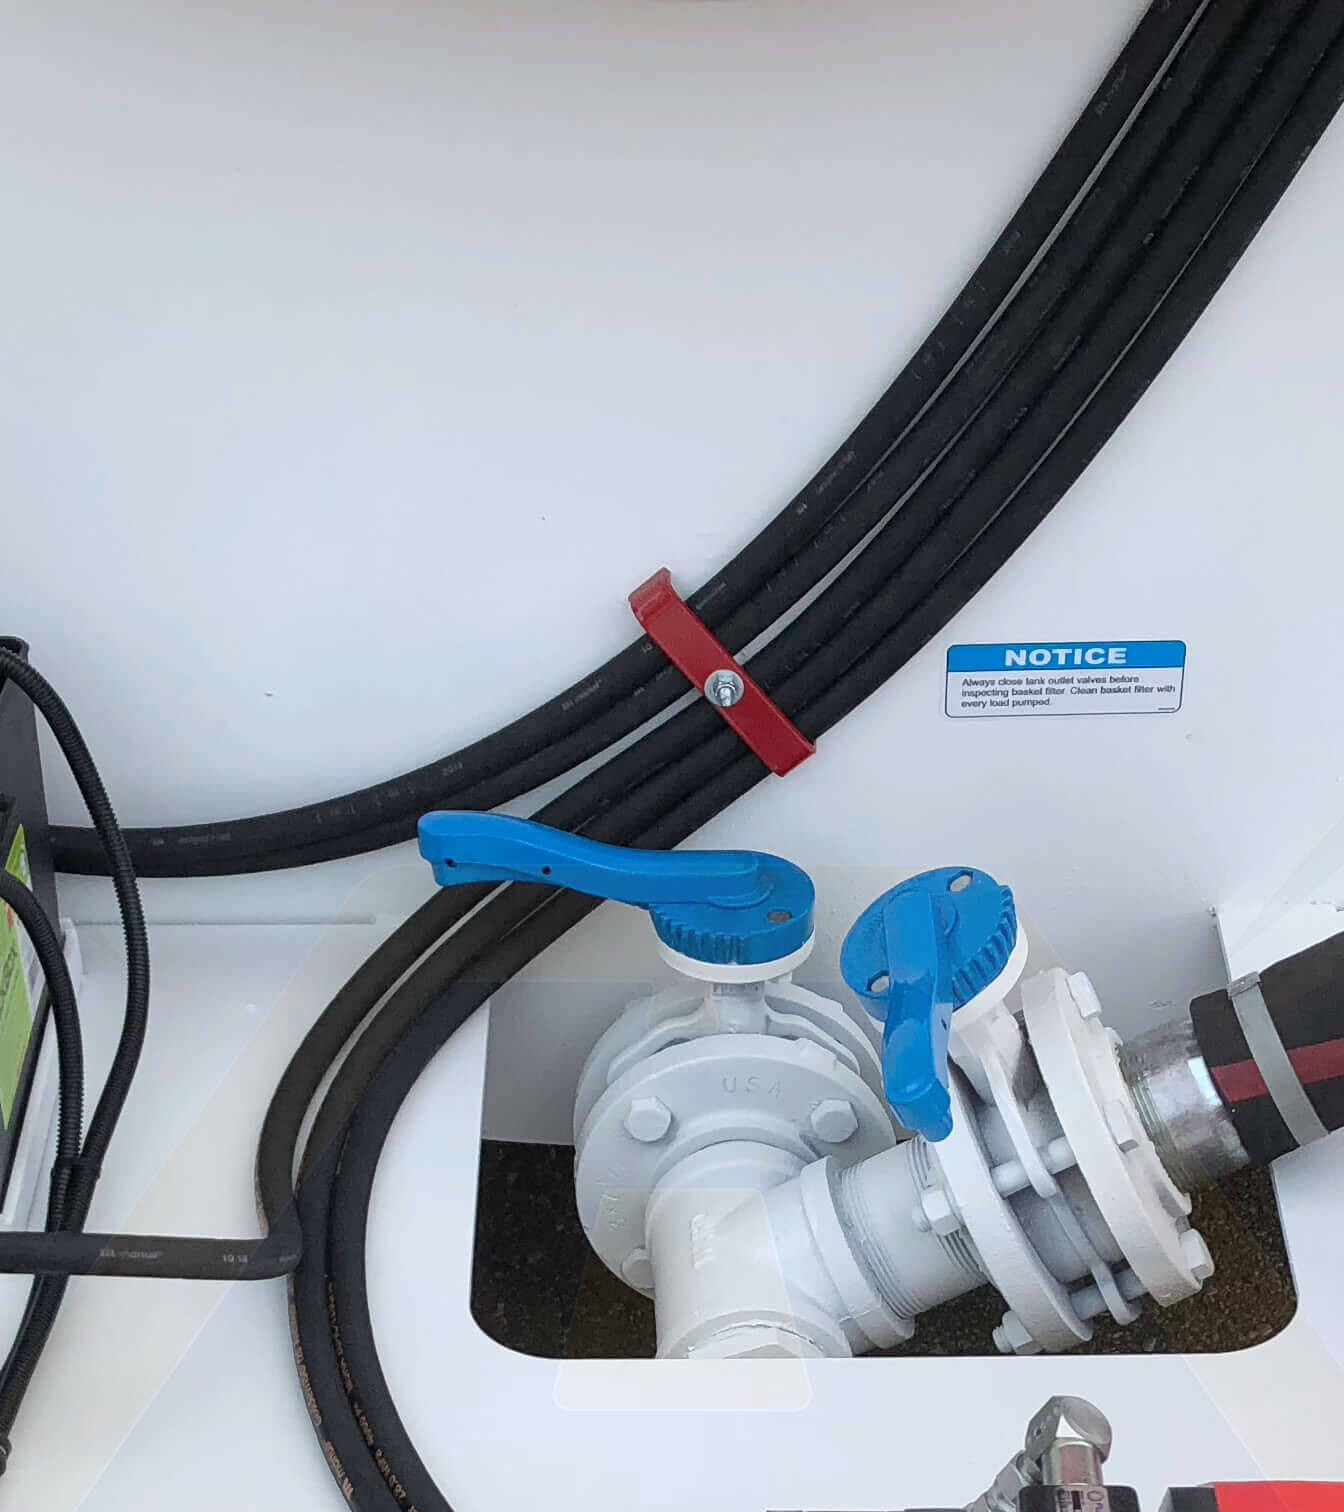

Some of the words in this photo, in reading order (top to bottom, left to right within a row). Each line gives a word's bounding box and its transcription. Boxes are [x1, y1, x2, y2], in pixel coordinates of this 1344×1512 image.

[1005, 648, 1127, 666] NOTICE
[962, 678, 995, 687] Always
[1026, 677, 1045, 685] tank
[1077, 676, 1106, 684] valves
[1109, 675, 1139, 683] before
[962, 688, 1009, 697] inspecting
[1012, 687, 1043, 695] basket
[1070, 686, 1098, 695] Clean
[1101, 686, 1131, 694] basket
[1134, 685, 1154, 693] filter
[1156, 684, 1175, 693] with
[961, 700, 987, 708] every
